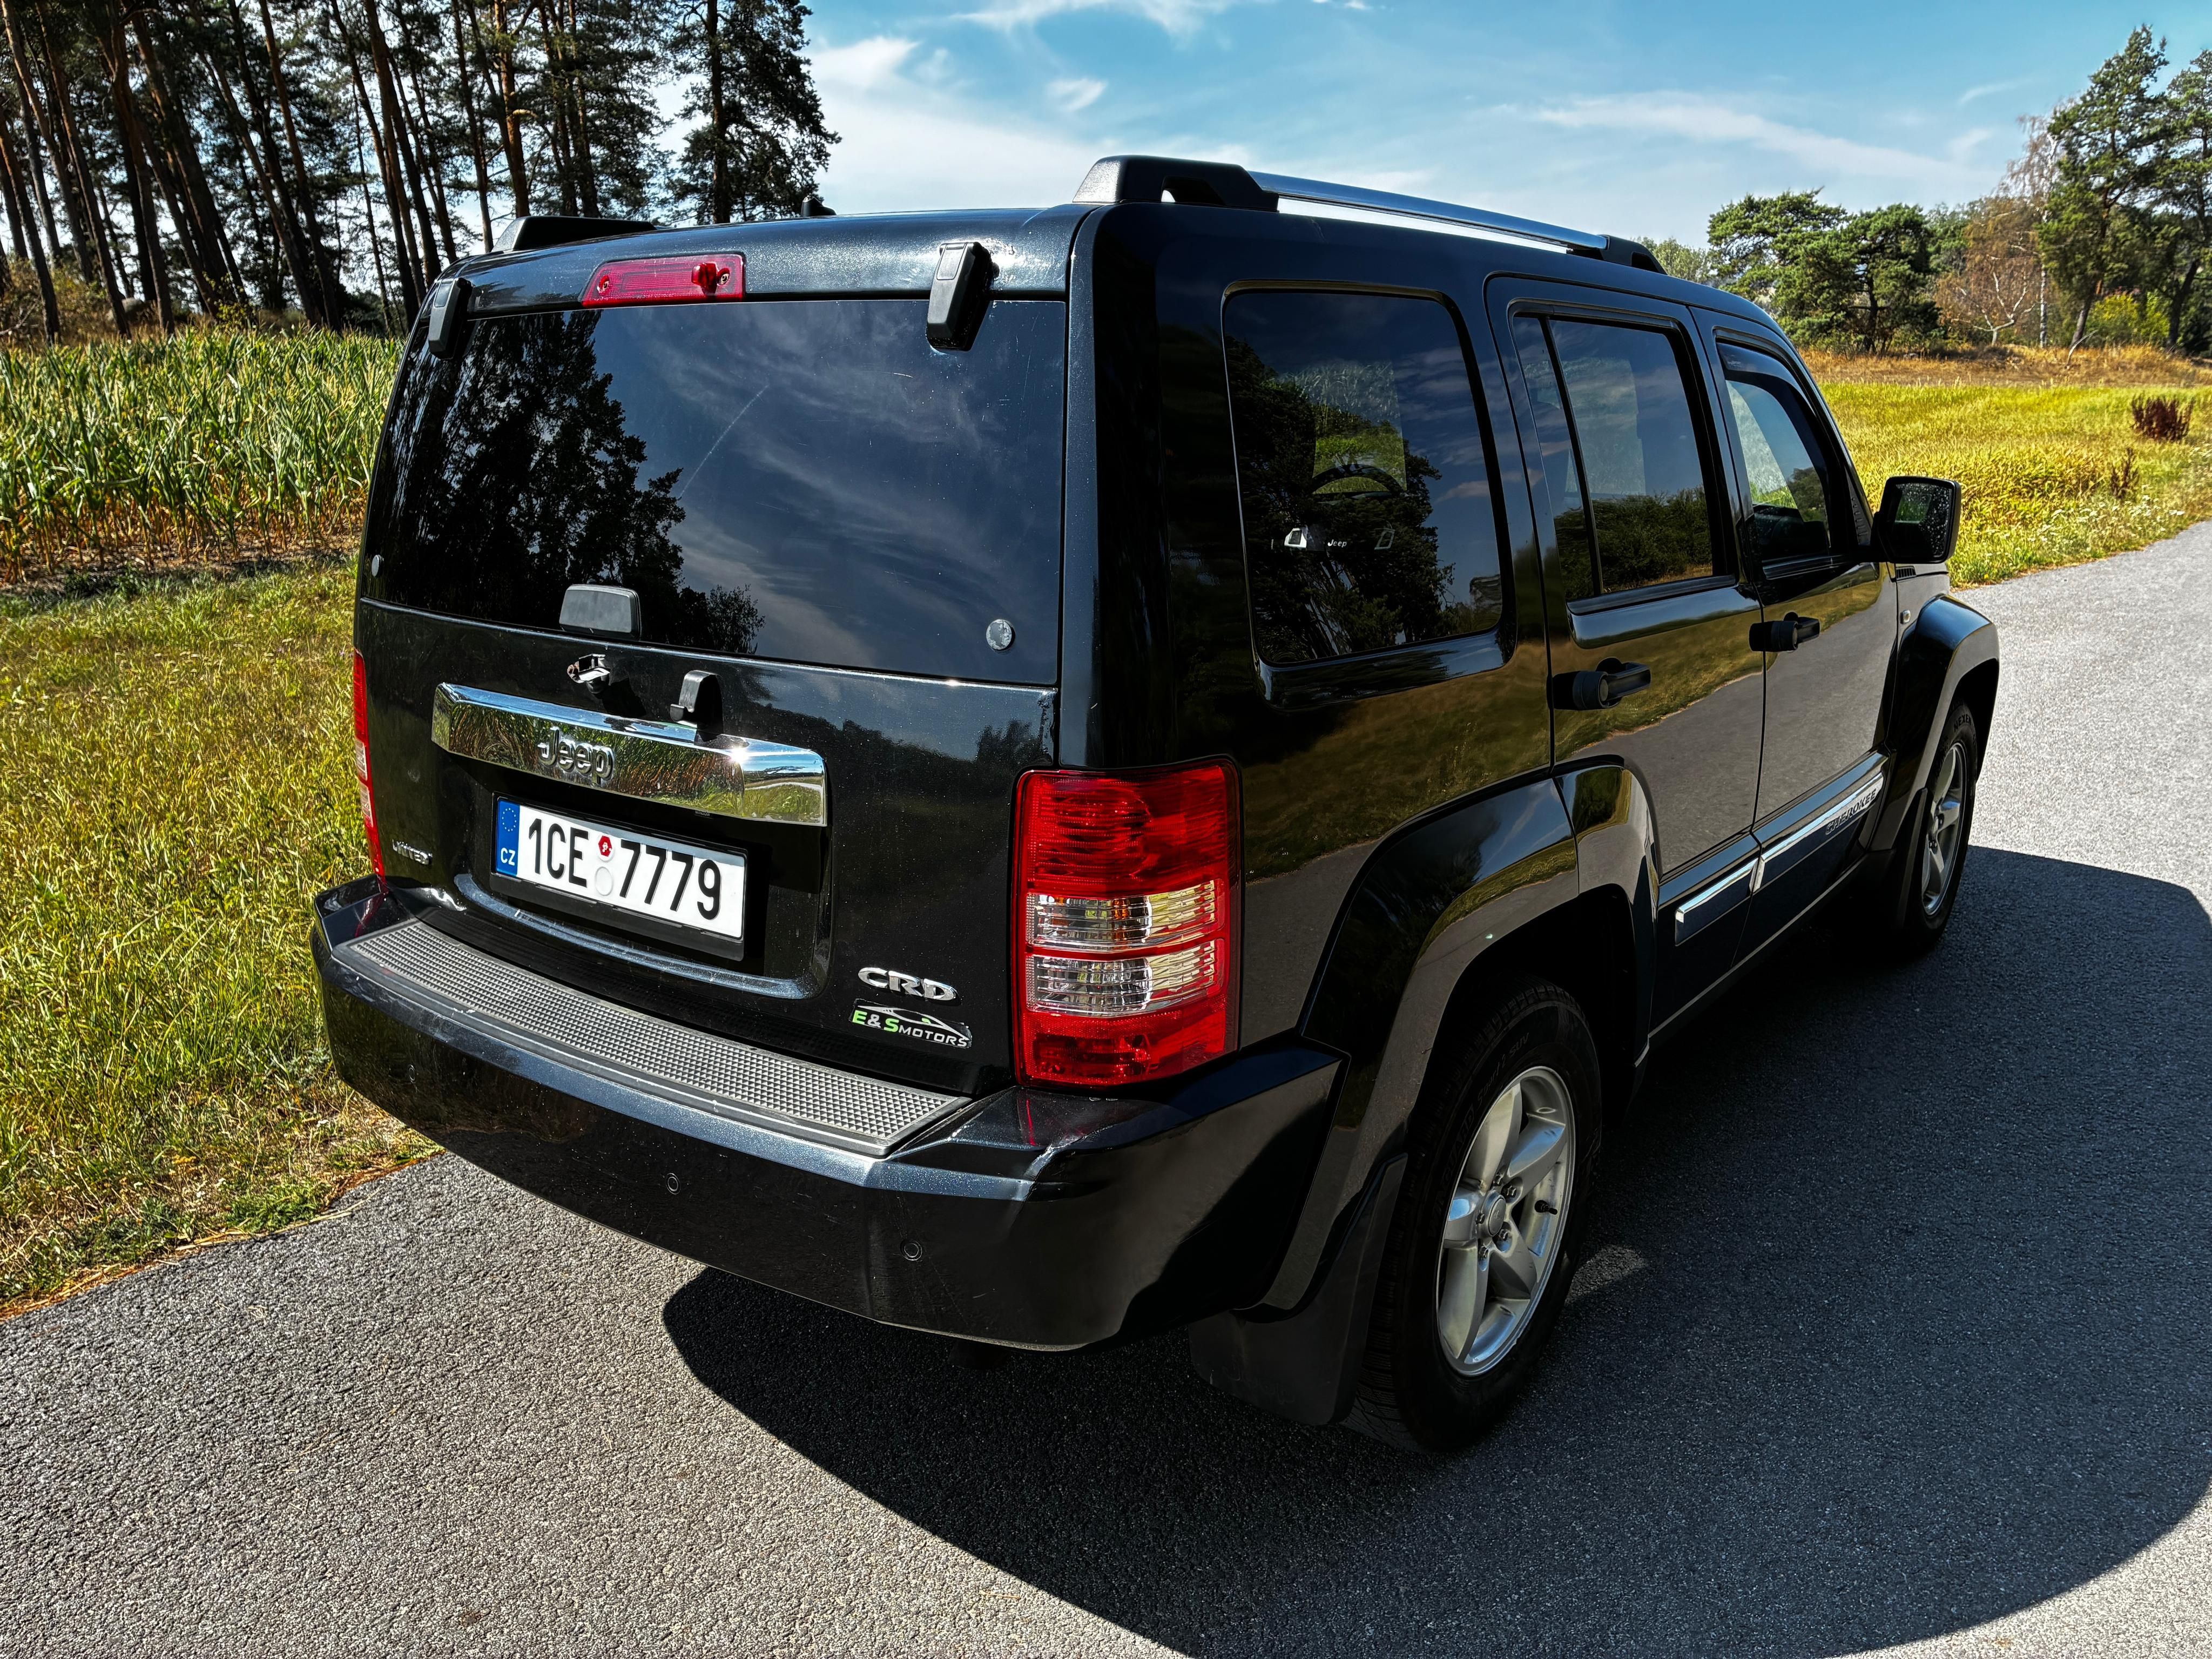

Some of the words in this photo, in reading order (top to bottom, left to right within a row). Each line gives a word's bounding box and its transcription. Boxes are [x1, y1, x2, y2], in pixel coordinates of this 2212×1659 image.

[1327, 539, 1347, 548] Jeep
[537, 726, 615, 787] Jeep
[1825, 788, 1877, 835] CHEROKEE
[500, 847, 516, 866] CZ
[528, 818, 590, 888] 1CE
[619, 839, 721, 920] 7779
[858, 967, 957, 1001] CRD
[852, 1010, 900, 1033] E&S
[898, 1025, 968, 1047] MOTORS
[1509, 1032, 1529, 1056] SUV
